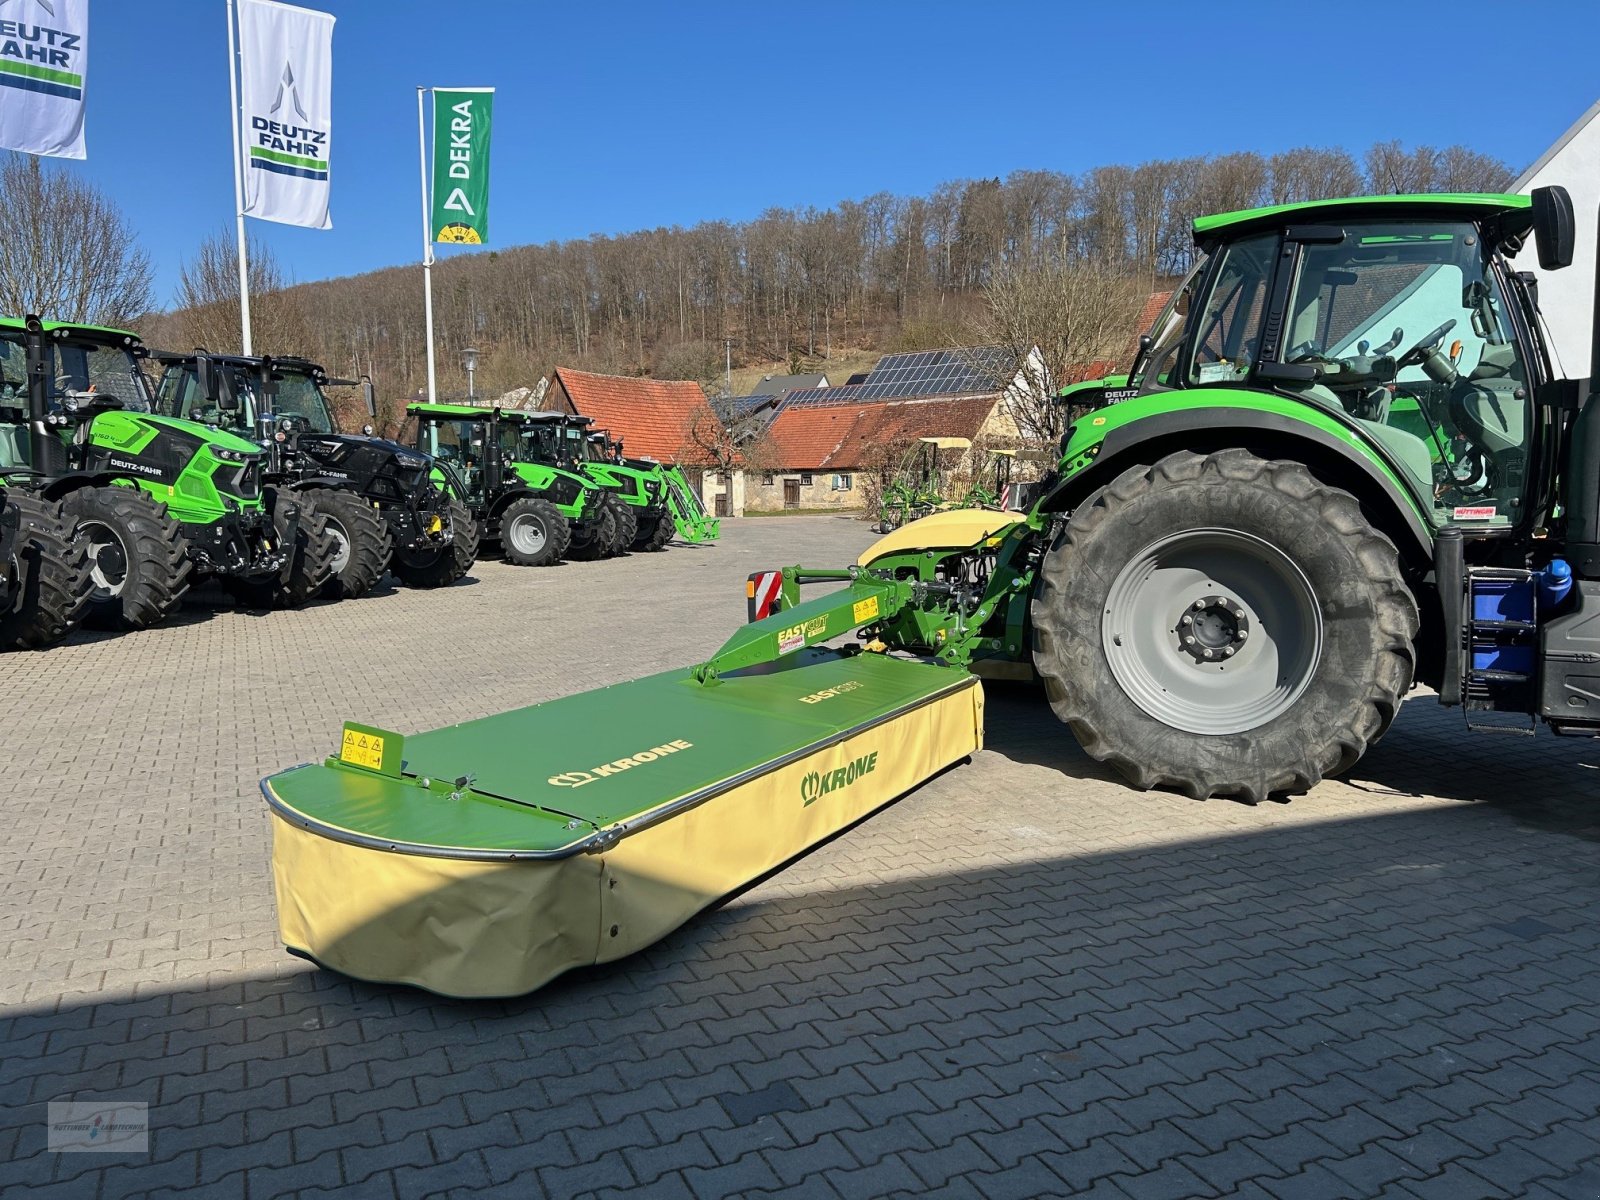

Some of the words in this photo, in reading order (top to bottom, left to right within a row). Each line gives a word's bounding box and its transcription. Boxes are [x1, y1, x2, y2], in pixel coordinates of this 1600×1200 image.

[0, 20, 81, 51] EUTZ
[0, 39, 70, 68] AHR
[252, 116, 326, 144] DEUTZ
[449, 99, 473, 180] DEKRA
[259, 132, 319, 158] FAHR
[1105, 390, 1139, 398] DEUTZ
[110, 458, 162, 476] DEUTZ-FAHR
[319, 470, 348, 479] TZ-FAHR
[590, 739, 694, 778] KRONE
[818, 750, 879, 798] KRONE
